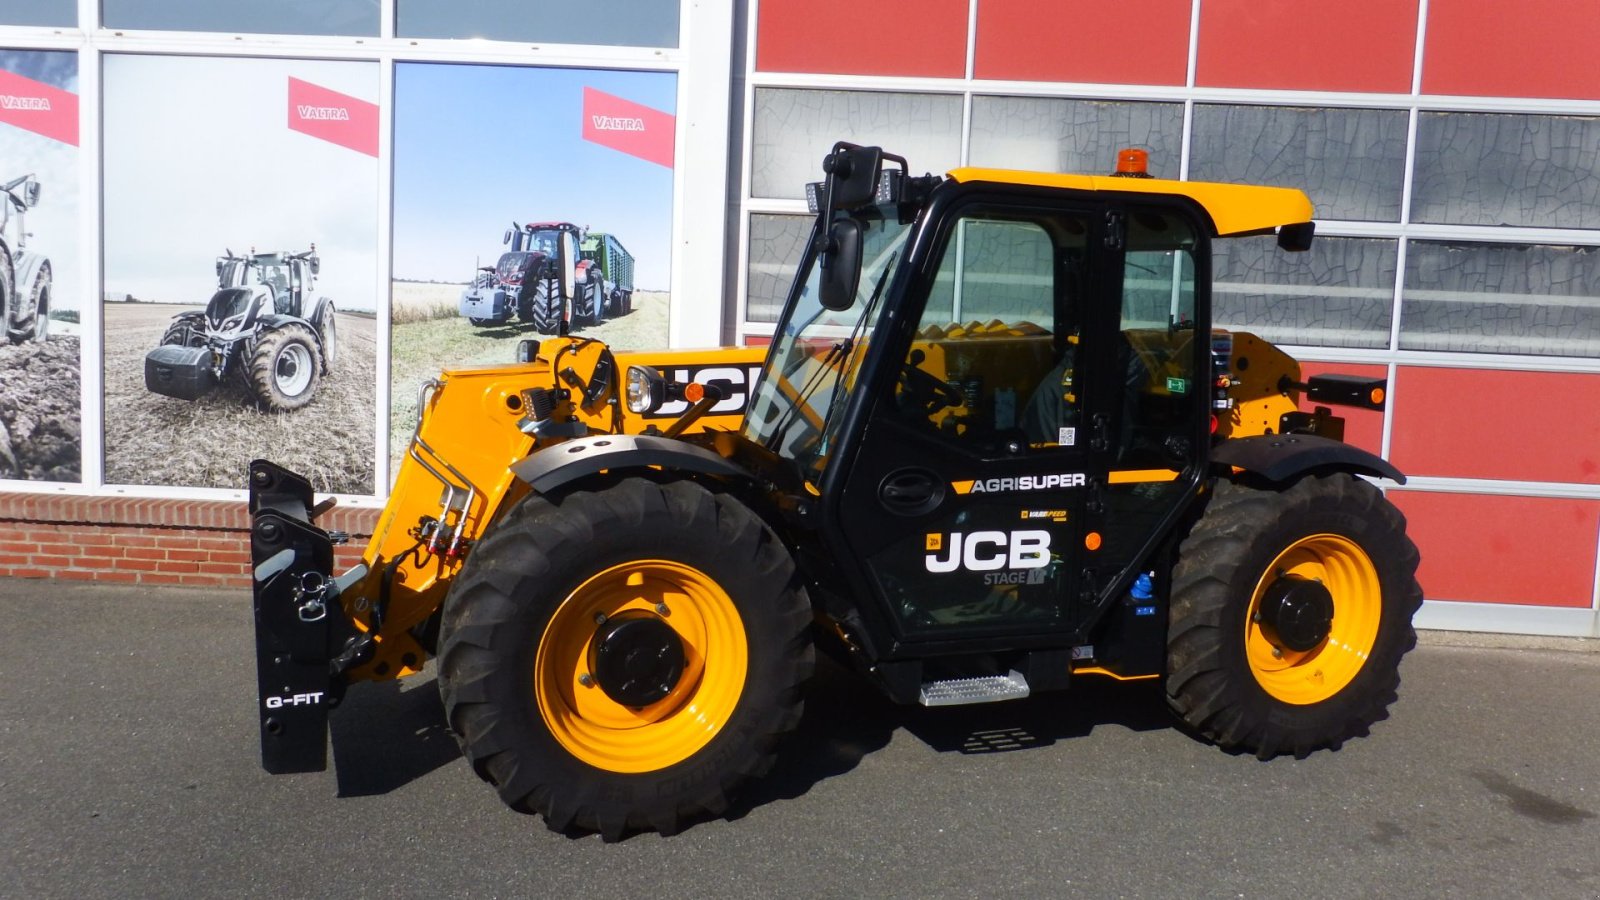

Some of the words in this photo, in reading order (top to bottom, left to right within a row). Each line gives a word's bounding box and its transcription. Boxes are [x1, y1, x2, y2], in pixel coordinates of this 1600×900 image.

[0, 95, 51, 111] VALTRA
[297, 105, 349, 120] VALTRA
[593, 115, 645, 131] VALTRA
[925, 530, 1051, 573] JCB
[983, 571, 1026, 585] STAGE
[266, 692, 324, 708] Q-FIT
